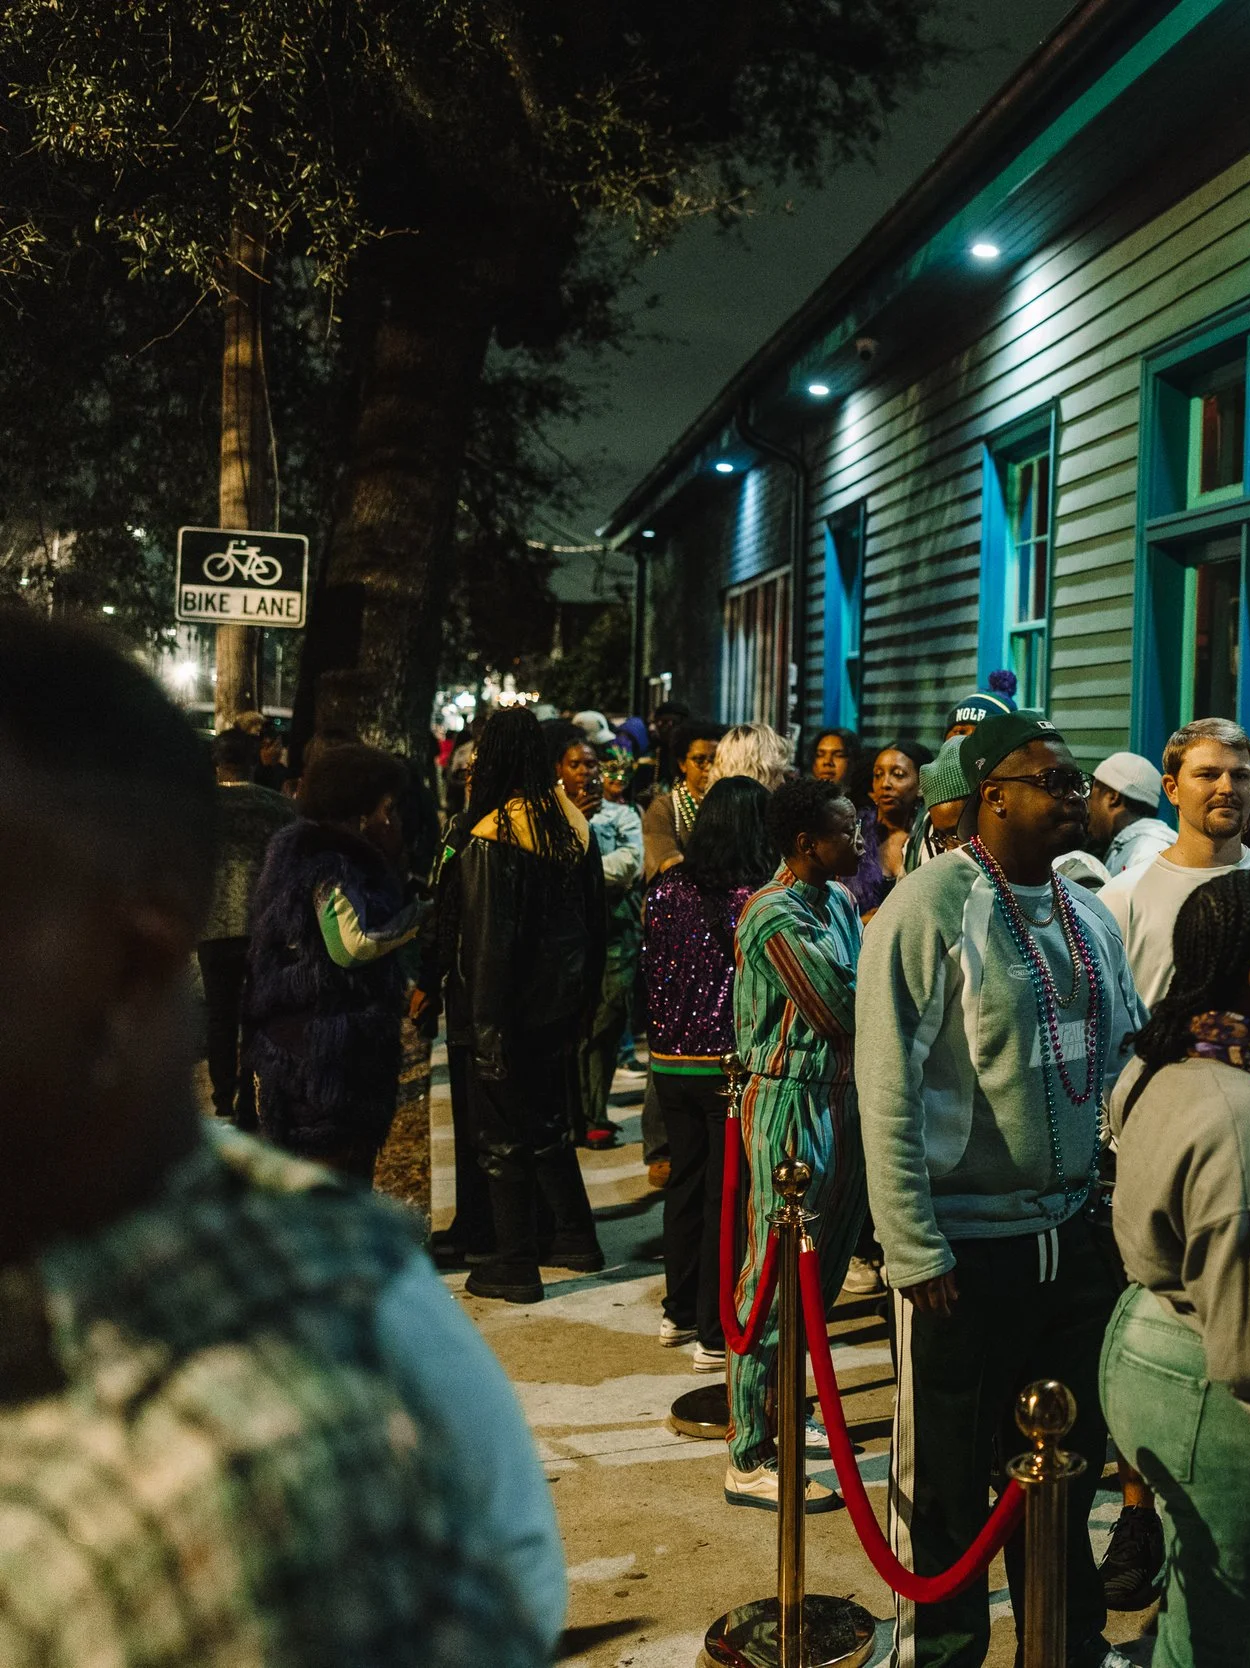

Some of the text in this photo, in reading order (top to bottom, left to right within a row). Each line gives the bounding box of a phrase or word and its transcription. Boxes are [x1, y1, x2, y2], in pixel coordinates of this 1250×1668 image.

[183, 591, 298, 618] BIKE LANE
[956, 707, 987, 722] NOLA
